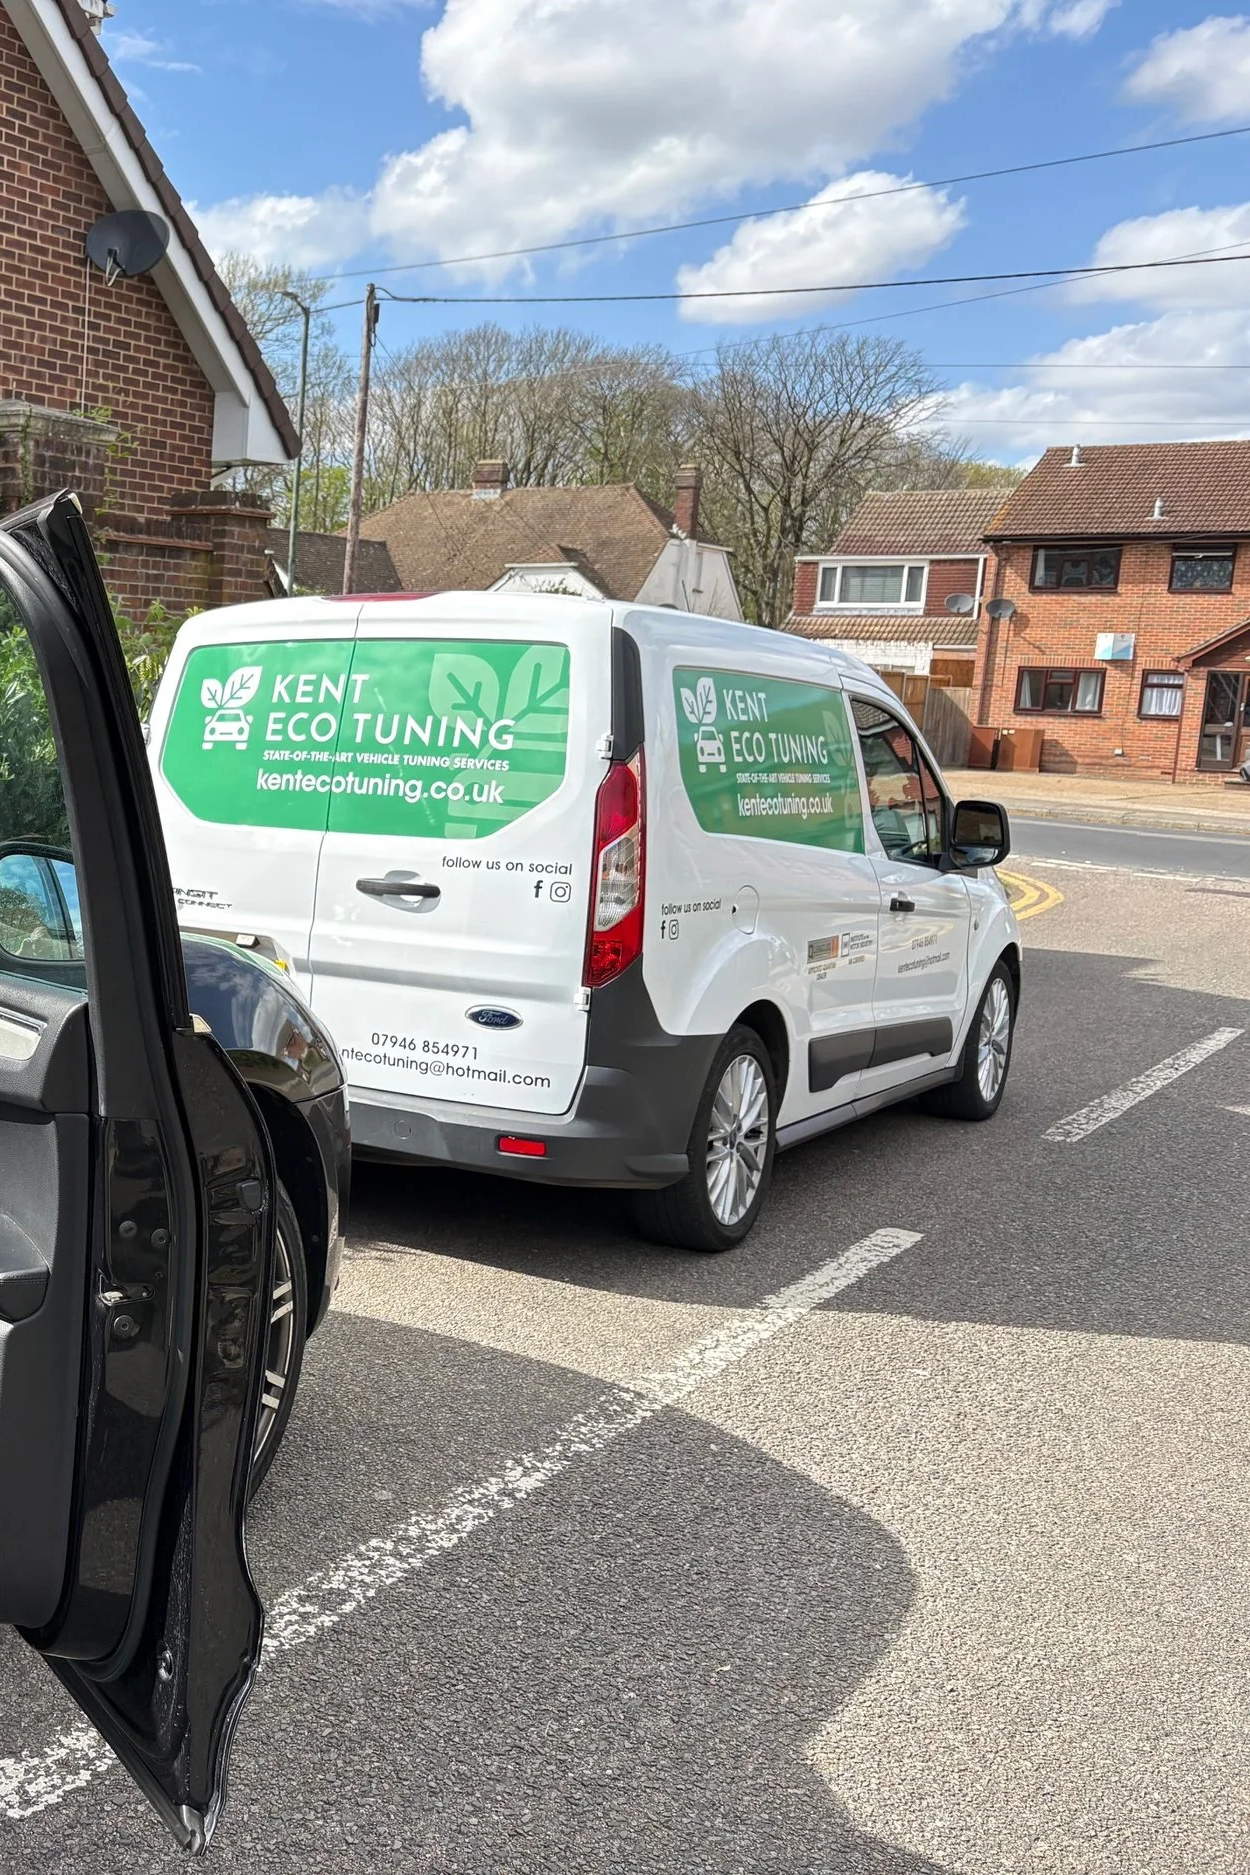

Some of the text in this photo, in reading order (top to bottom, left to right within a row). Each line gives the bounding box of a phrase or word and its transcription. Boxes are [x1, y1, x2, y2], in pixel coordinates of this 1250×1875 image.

[271, 673, 370, 704] KENT
[722, 688, 768, 722] KENT
[265, 711, 516, 751] ECO TUNING
[262, 749, 510, 771] STATE-OF-THE-ART VEHICLE TUNING SERVICES
[730, 731, 828, 765] ECO TUNING
[256, 768, 506, 804] kentecotuning.co.uk
[812, 773, 831, 784] SERVICES
[737, 792, 833, 820] kentecotuning.co.uk
[442, 856, 573, 875] follow us on social
[173, 887, 219, 900] NSIT
[661, 898, 722, 915] follow us on social
[478, 1010, 508, 1025] Ford
[371, 1032, 478, 1060] 07946 854971
[341, 1047, 551, 1089] ntecotuning@hotmail.com
